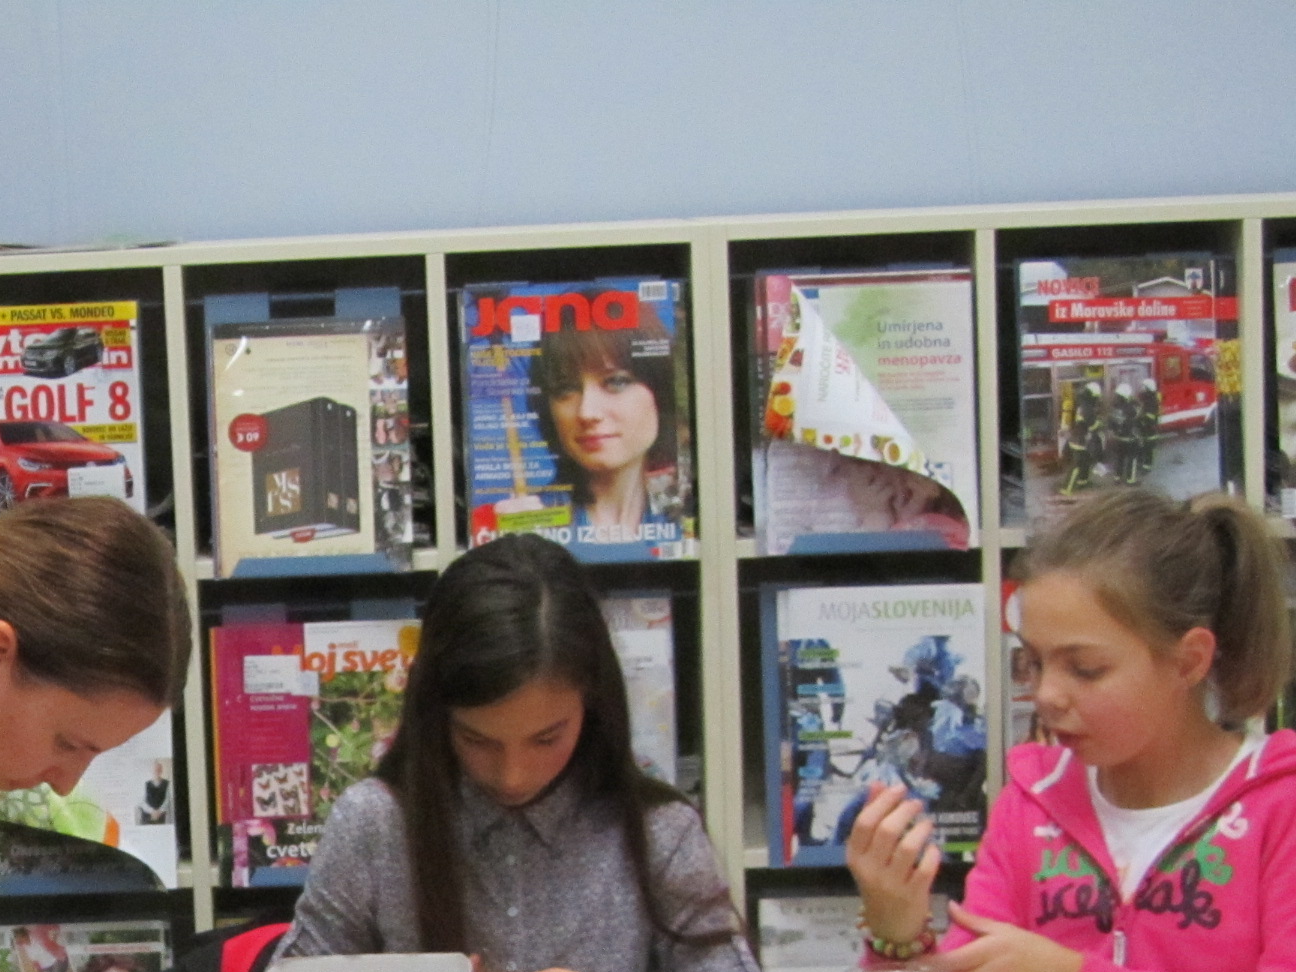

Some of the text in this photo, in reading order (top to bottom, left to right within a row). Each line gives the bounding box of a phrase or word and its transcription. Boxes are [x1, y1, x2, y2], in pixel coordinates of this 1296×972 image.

[10, 308, 48, 322] PASSAT
[50, 307, 67, 320] VS.
[70, 305, 115, 318] MONDEO
[1054, 303, 1067, 318] iz
[1137, 300, 1176, 317] doline
[877, 320, 943, 334] Umirjena
[878, 336, 951, 349] in udobna
[878, 353, 962, 369] menopavza
[5, 383, 95, 423] GOLF
[108, 381, 131, 421] 8
